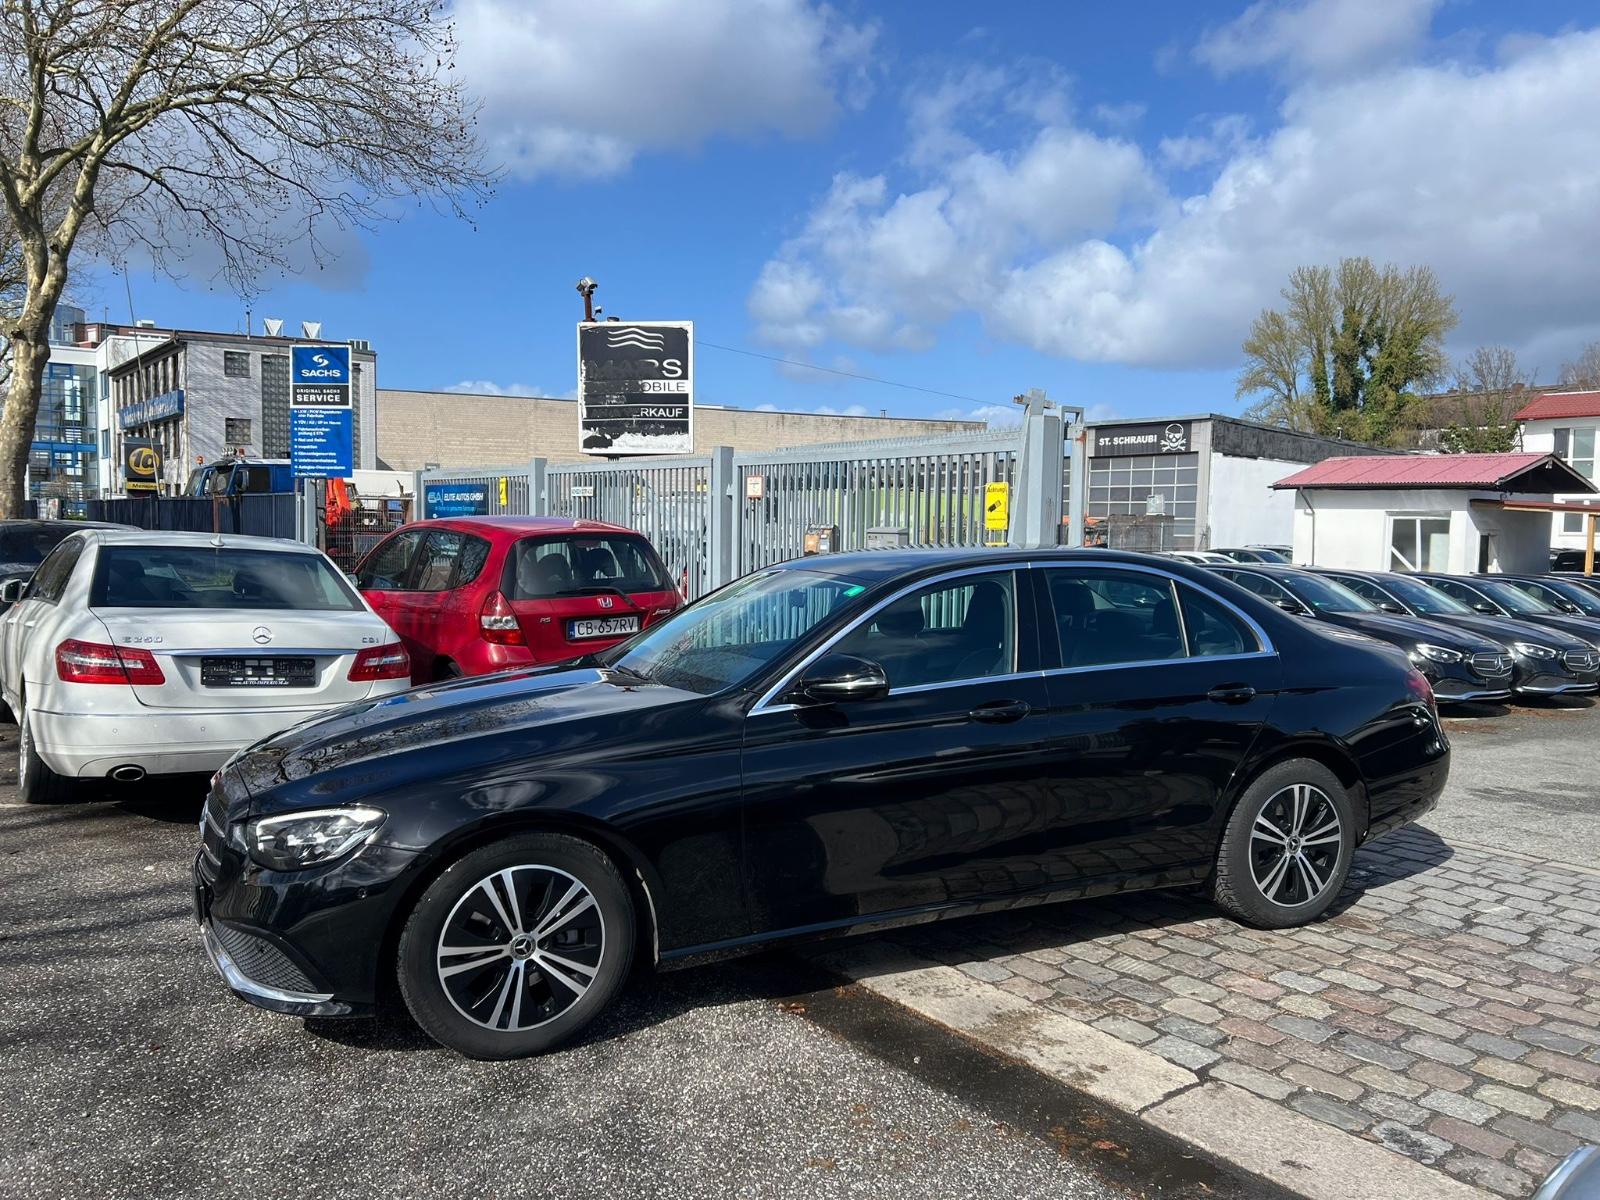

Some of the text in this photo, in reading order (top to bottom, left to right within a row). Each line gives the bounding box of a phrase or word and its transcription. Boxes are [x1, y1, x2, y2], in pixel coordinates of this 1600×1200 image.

[301, 369, 341, 377] SACHS
[641, 382, 686, 392] OBILE
[633, 408, 683, 418] RKAUF
[1099, 434, 1157, 446] ST. SCHRAUBI
[456, 493, 470, 501] AUTOS
[577, 617, 635, 636] CB 657RV
